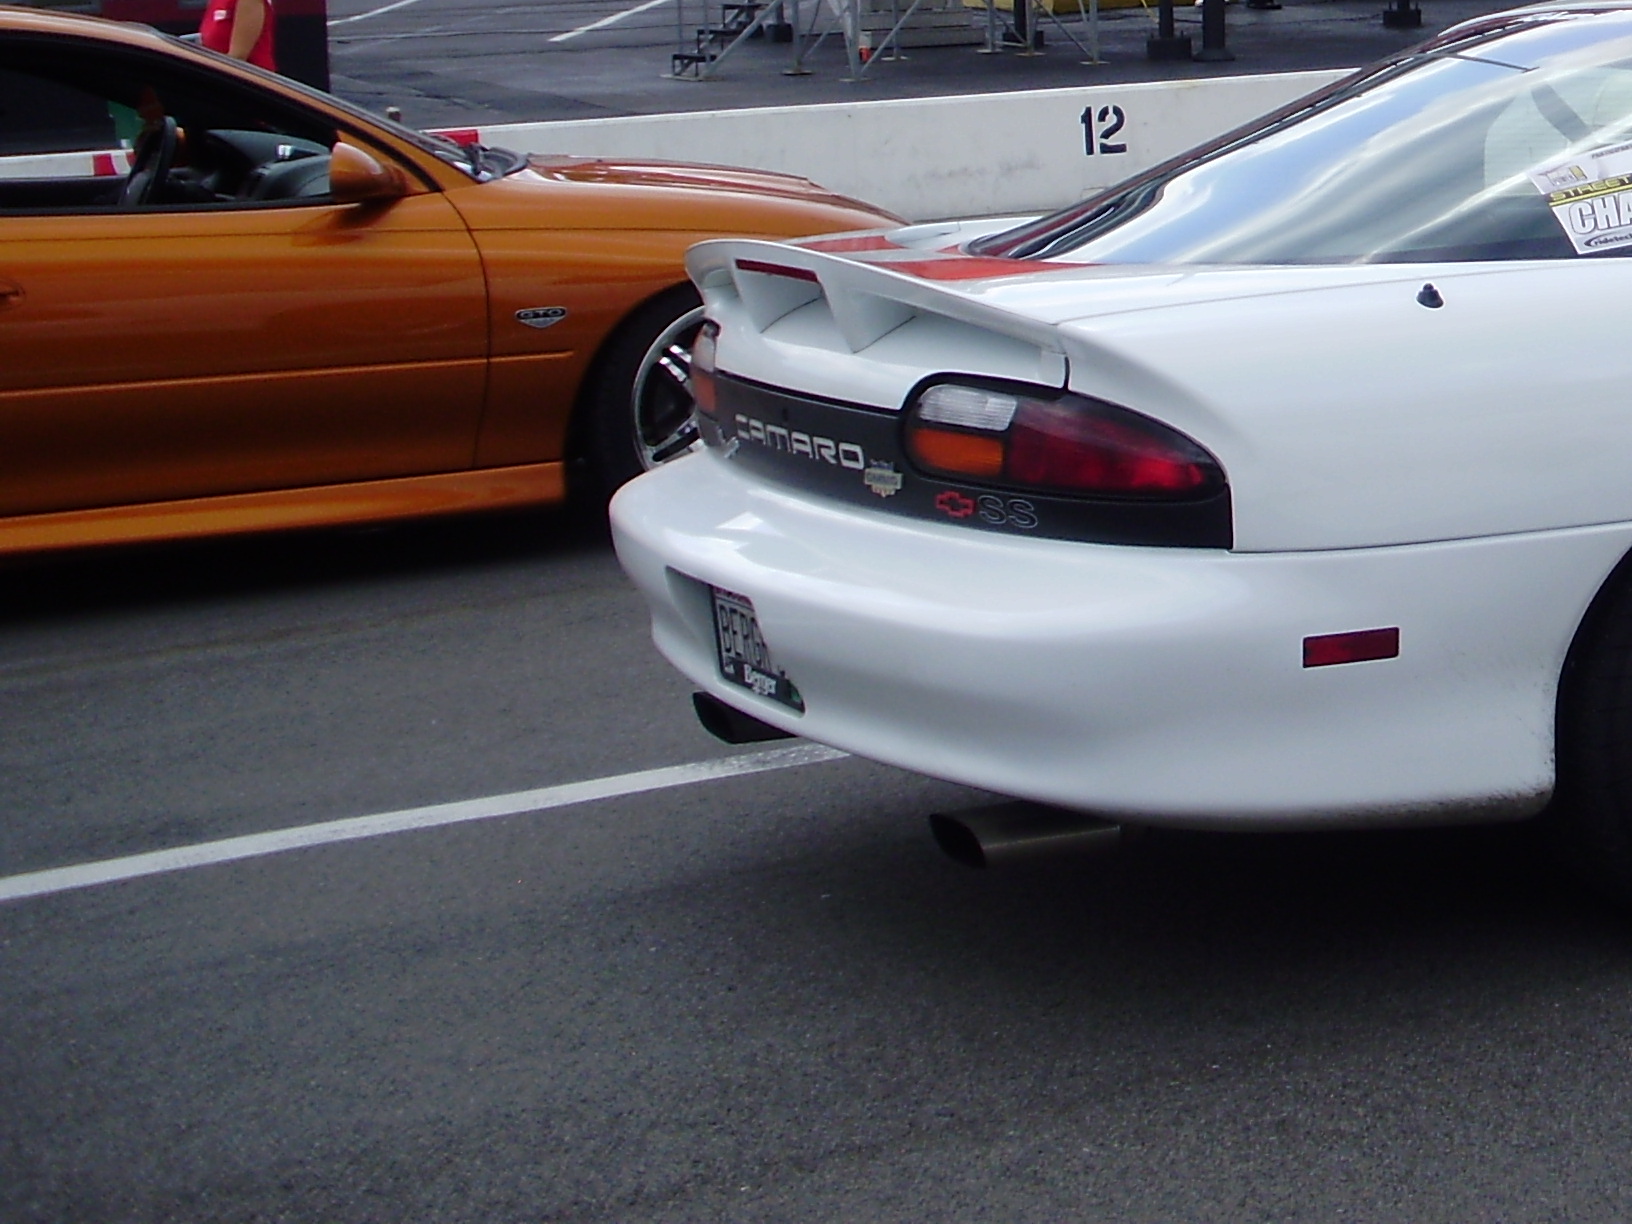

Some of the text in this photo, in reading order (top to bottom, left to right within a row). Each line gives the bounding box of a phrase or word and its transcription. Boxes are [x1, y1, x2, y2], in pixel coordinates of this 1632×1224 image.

[1080, 104, 1128, 156] 12
[1550, 174, 1632, 202] STREET
[520, 309, 562, 319] GTO
[734, 413, 865, 471] CAMARO
[976, 494, 1038, 529] SS
